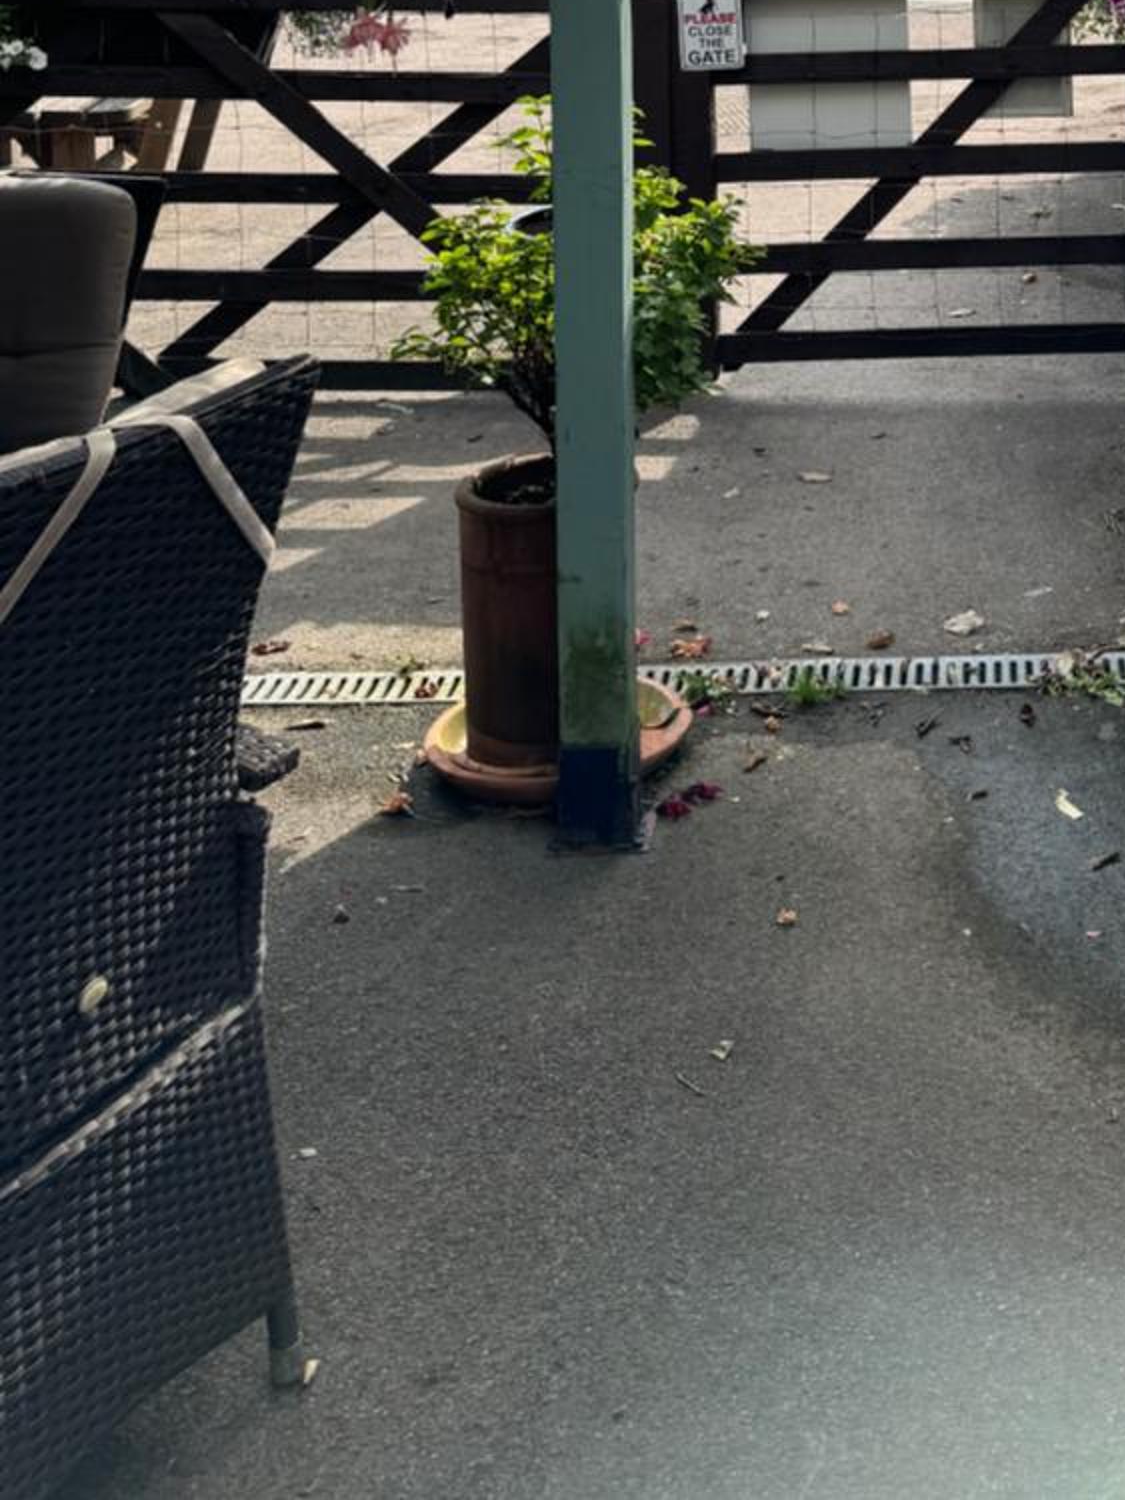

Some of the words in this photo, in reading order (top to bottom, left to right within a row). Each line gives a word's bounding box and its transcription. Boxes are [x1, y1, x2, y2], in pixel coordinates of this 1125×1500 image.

[684, 13, 737, 25] PLEASE
[687, 26, 733, 37] CLOSE
[699, 38, 724, 49] THE
[687, 49, 736, 66] GATE
